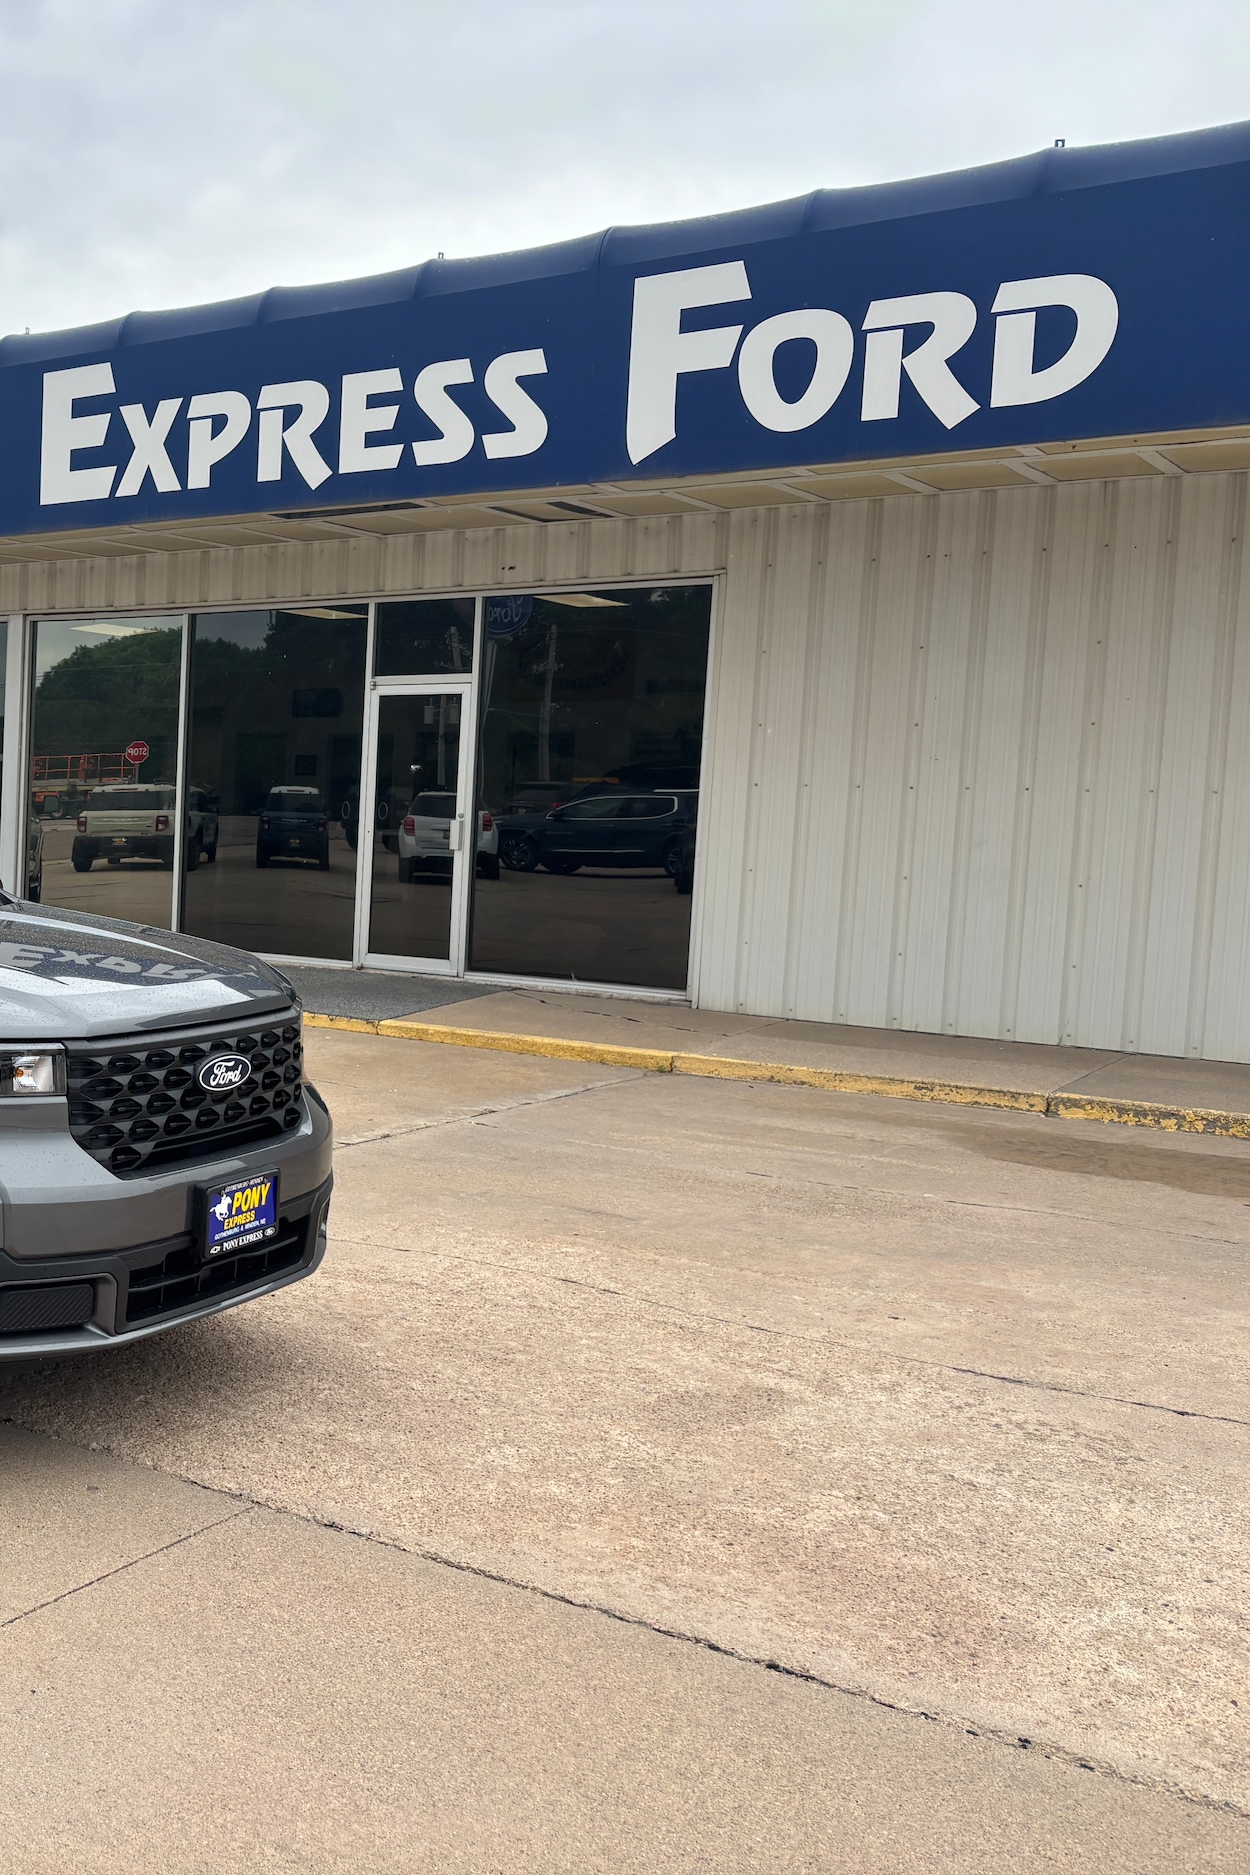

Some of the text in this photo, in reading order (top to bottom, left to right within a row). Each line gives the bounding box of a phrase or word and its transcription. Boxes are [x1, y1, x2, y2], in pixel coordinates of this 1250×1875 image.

[39, 348, 548, 507] EXPRESS
[626, 260, 1119, 466] FORD
[210, 1060, 243, 1087] Ford
[232, 1182, 271, 1215] PONY
[224, 1210, 256, 1231] EXPRESS
[223, 1237, 239, 1251] PONY
[239, 1230, 263, 1245] EXPRESS
